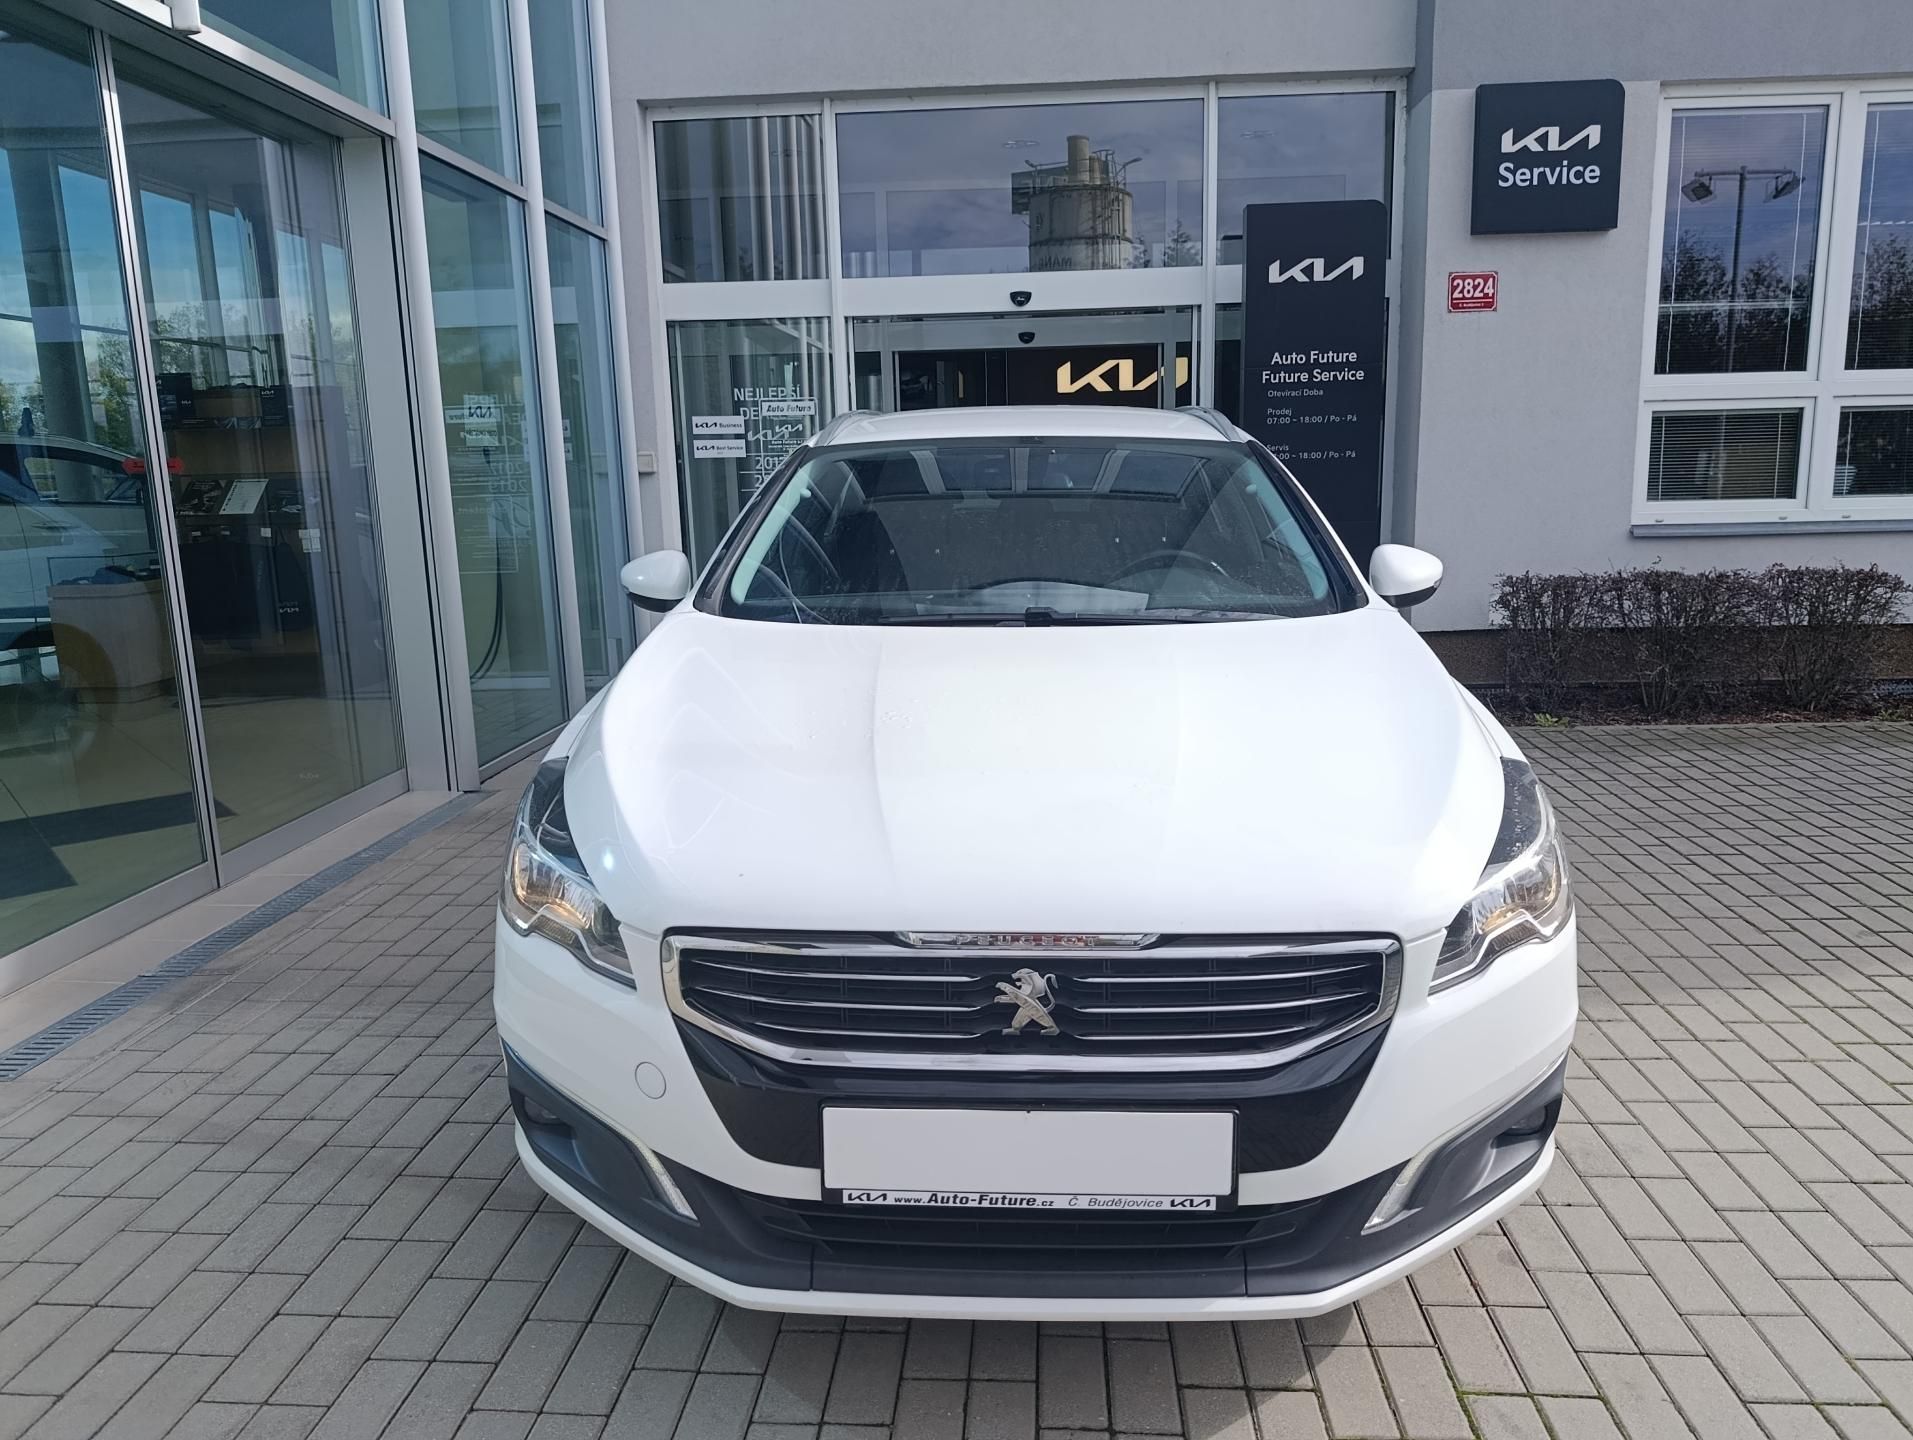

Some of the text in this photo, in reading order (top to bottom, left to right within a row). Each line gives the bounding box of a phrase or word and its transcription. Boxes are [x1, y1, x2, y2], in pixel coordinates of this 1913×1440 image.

[1501, 125, 1601, 153] KIA
[1498, 160, 1601, 187] Service
[1268, 256, 1364, 284] KIA
[1452, 277, 1494, 298] 2824
[1271, 350, 1358, 365] Auto Future
[1262, 367, 1365, 384] Future Service
[1303, 388, 1324, 396] Doba
[766, 404, 785, 413] Auto
[1267, 408, 1292, 416] Prodej
[1266, 417, 1291, 425] 07:00
[1300, 415, 1323, 423] 18:00
[1347, 414, 1357, 422] Pá
[1299, 451, 1322, 459] 18:00
[1346, 450, 1356, 458] Pá
[848, 1193, 888, 1202] KIA
[894, 1193, 1054, 1207] www.Auto-Future.cz
[1088, 1197, 1163, 1209] Budějovice
[1170, 1198, 1211, 1208] KIA
